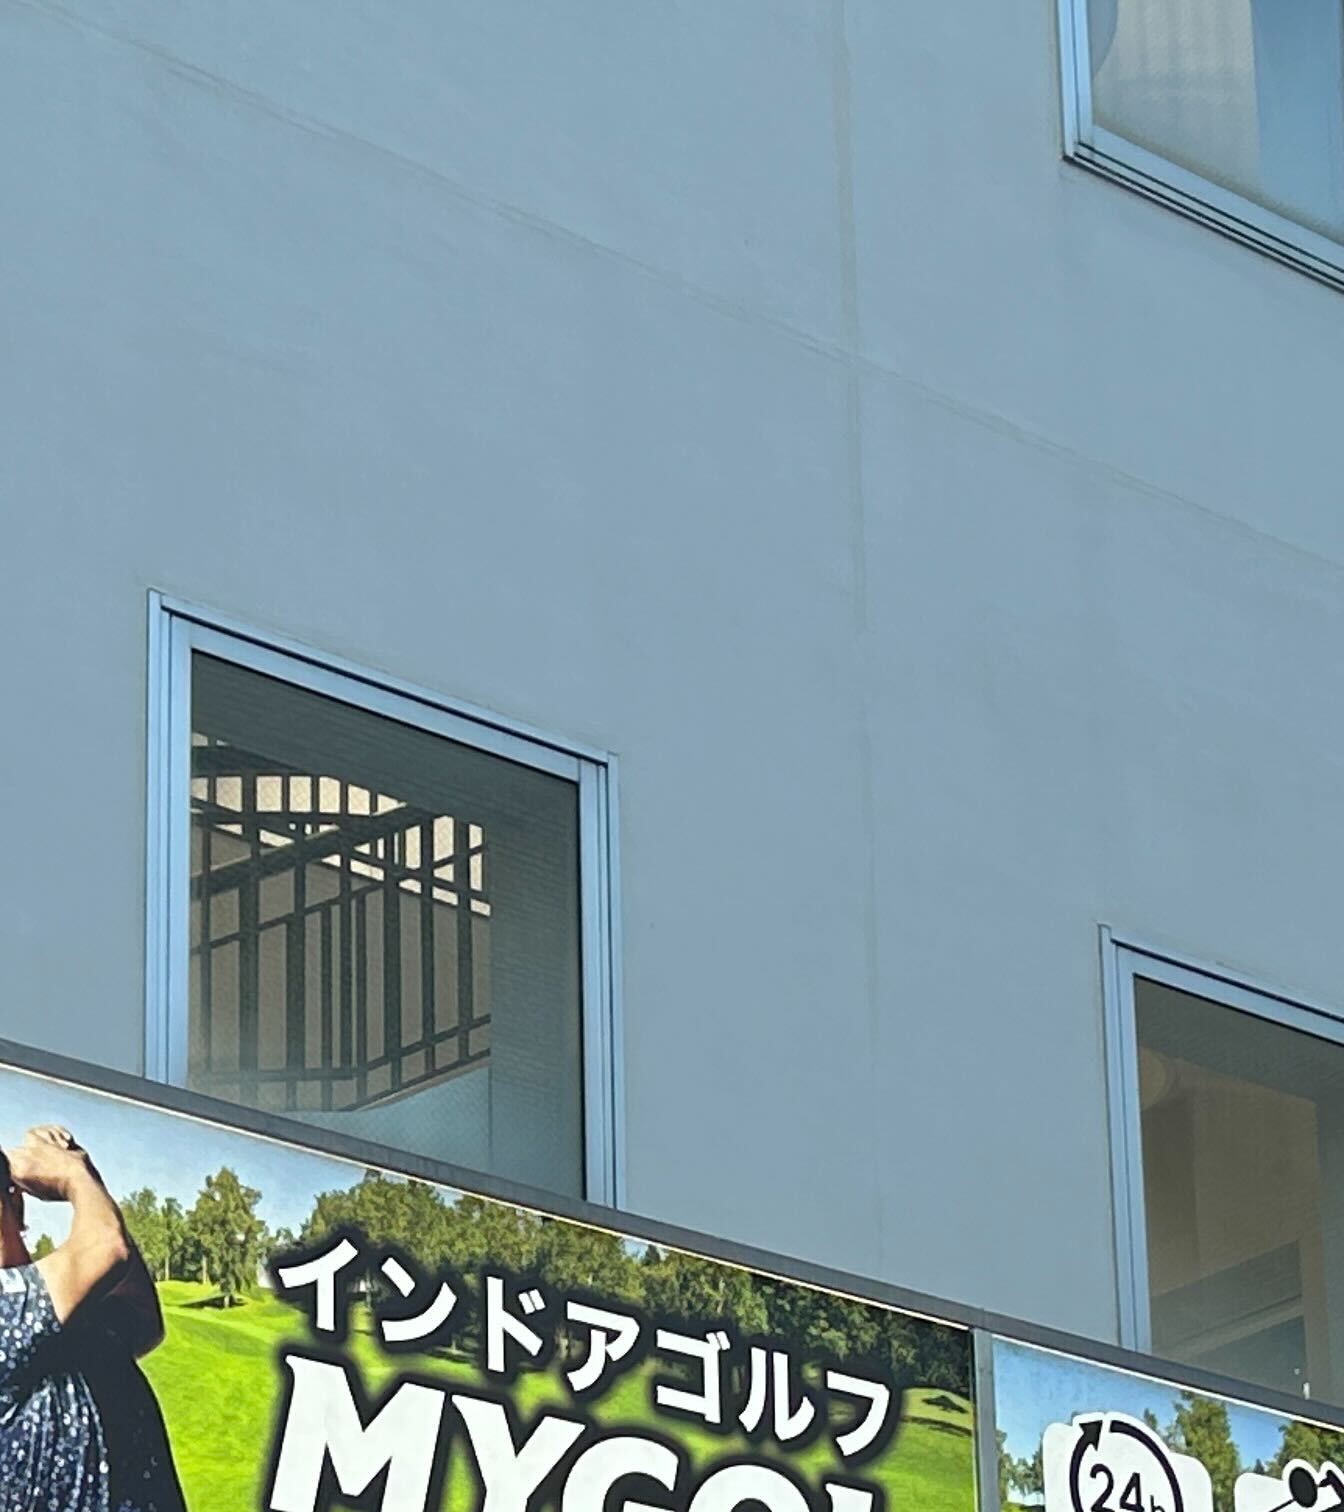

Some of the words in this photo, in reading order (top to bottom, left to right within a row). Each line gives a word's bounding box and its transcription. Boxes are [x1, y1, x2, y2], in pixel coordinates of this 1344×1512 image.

[279, 1238, 891, 1457] インドアゴルフ
